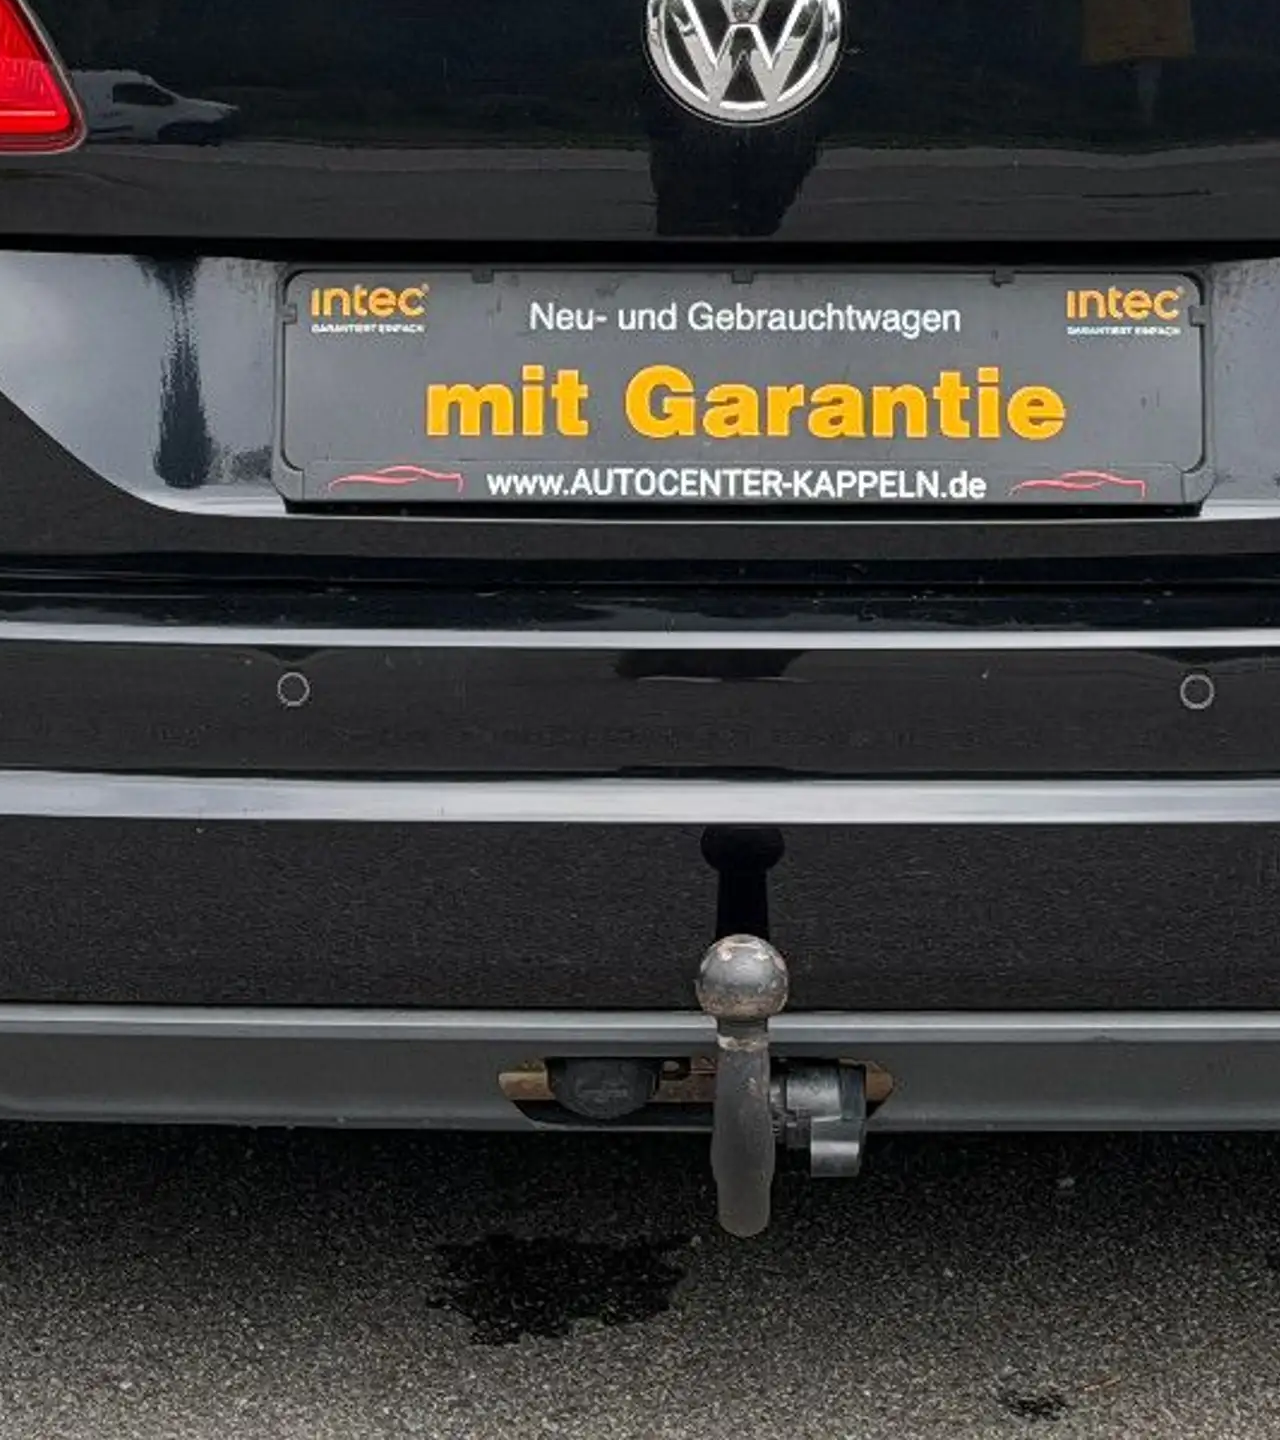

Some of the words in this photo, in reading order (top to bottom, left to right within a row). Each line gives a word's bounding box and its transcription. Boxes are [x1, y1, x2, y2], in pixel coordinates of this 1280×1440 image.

[529, 303, 607, 332] Neu-
[618, 302, 677, 332] und
[687, 301, 961, 339] Gebrauchtwagen
[426, 364, 588, 437] mit
[624, 364, 1066, 440] Garantie
[487, 467, 987, 499] www.AUTOCENTER-KAPPELN.de
